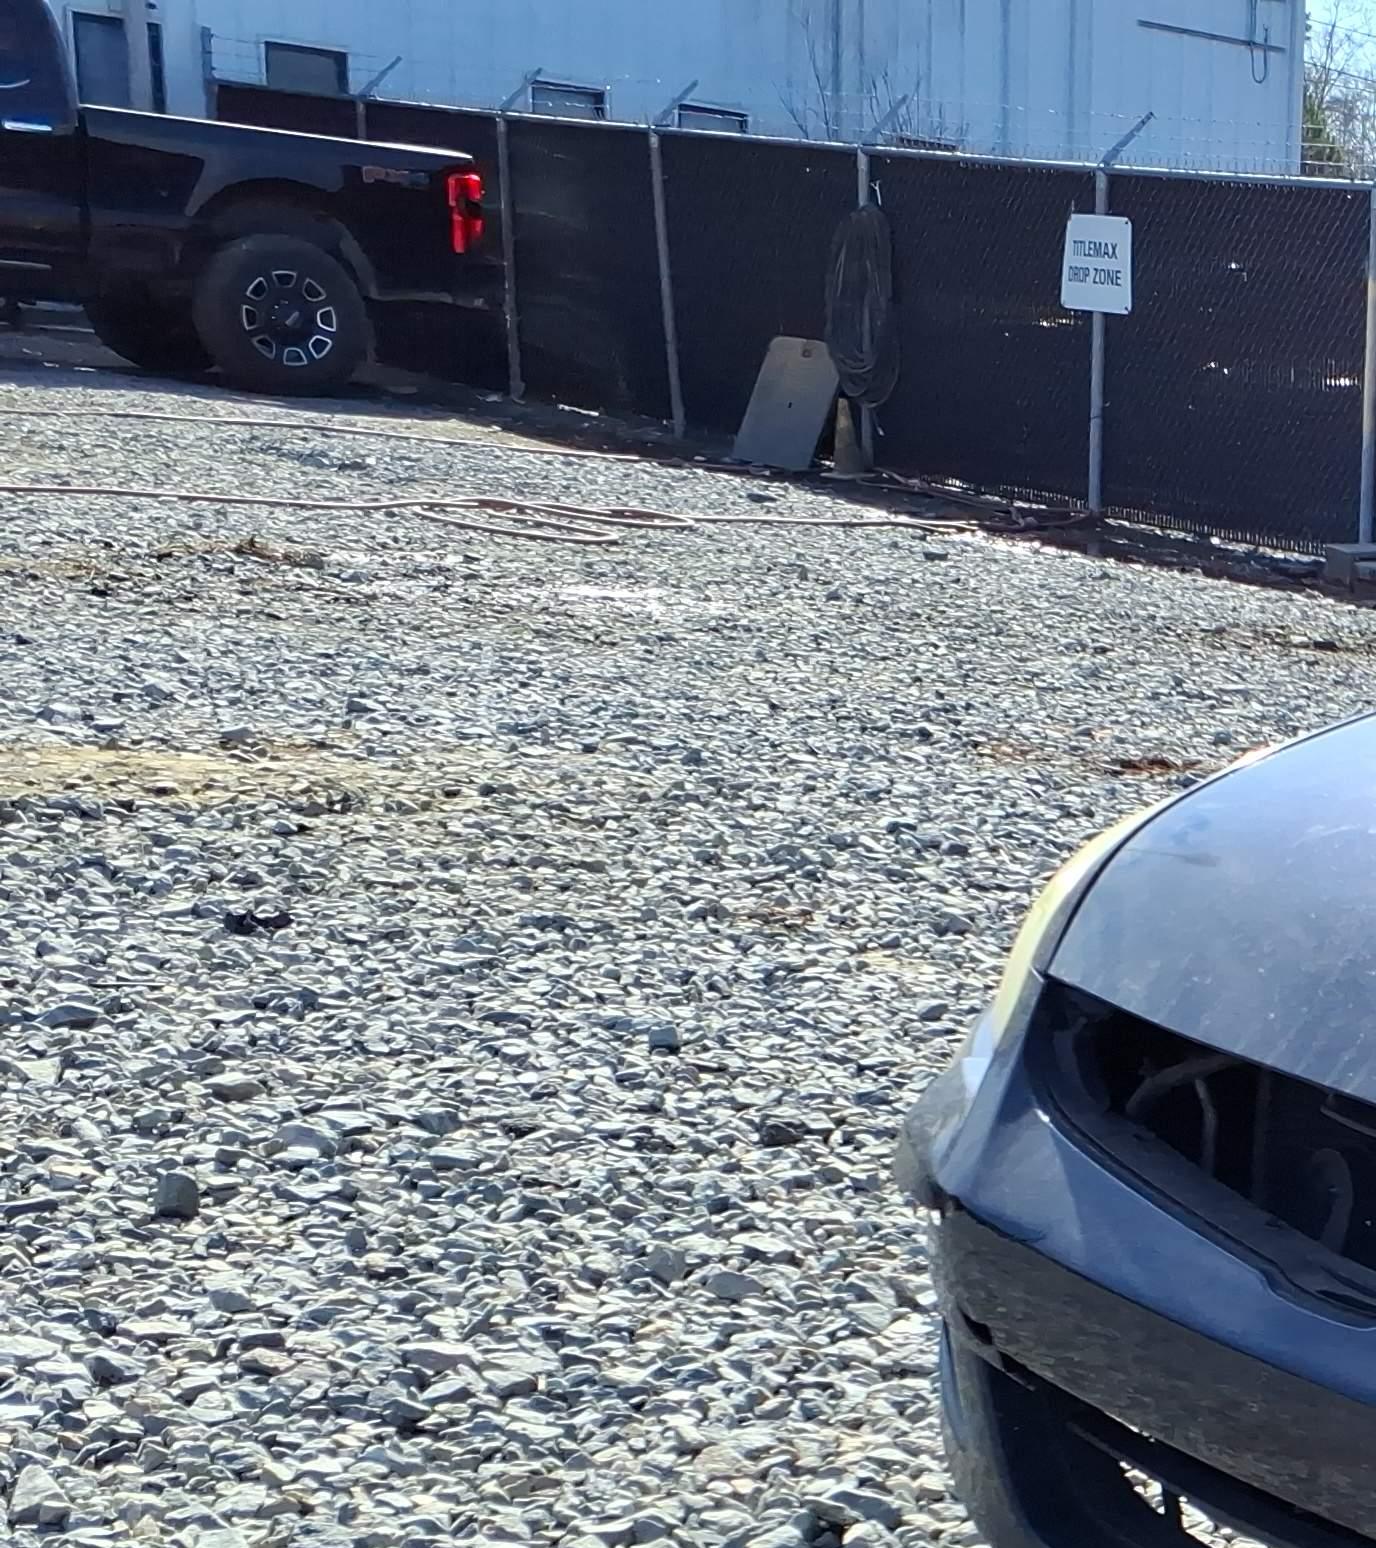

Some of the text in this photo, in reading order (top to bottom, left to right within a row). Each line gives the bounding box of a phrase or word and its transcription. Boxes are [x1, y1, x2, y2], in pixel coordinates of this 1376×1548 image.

[1072, 240, 1118, 260] TITLEMAX
[1067, 265, 1122, 287] DROP ZONE
